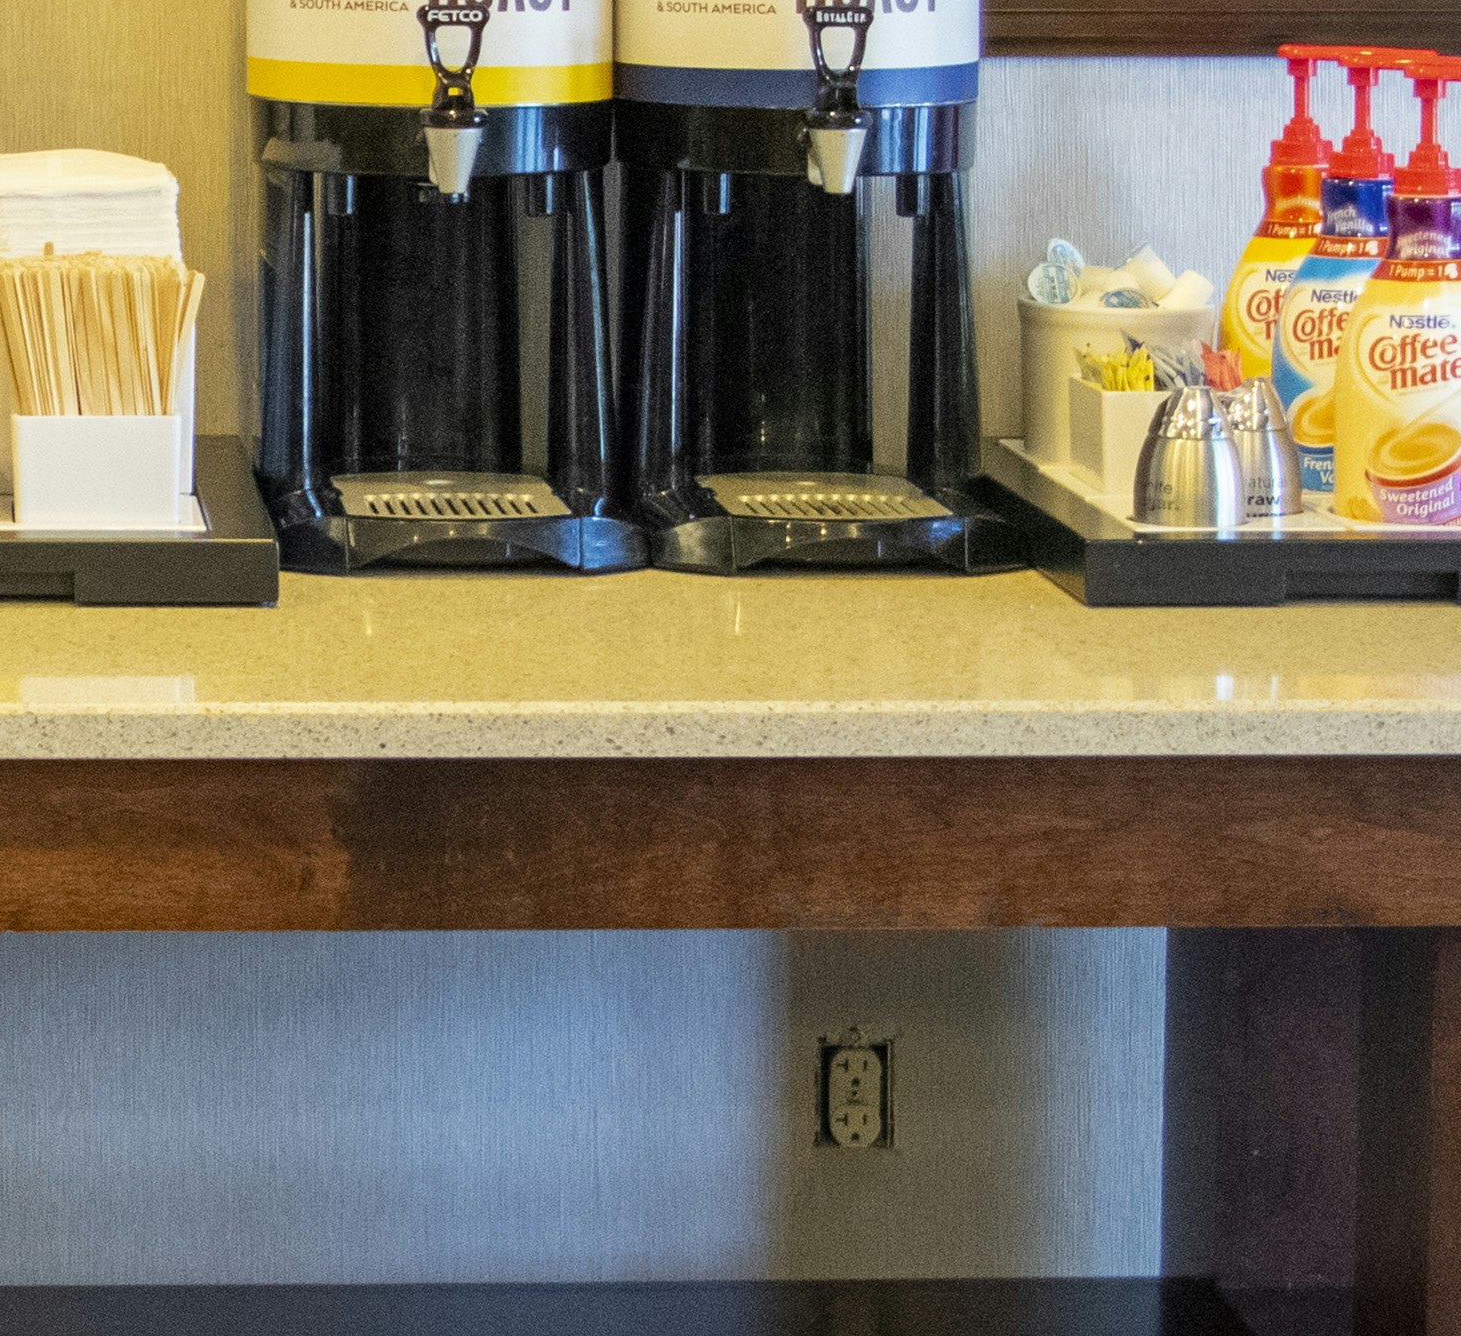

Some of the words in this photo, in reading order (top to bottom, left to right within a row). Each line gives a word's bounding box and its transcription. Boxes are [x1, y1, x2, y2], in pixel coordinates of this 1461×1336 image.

[289, 0, 297, 10] &
[299, 0, 341, 11] SOUTH
[344, 1, 409, 12] AMERICA
[656, 1, 664, 13] &
[666, 2, 708, 14] SOUTH
[711, 3, 777, 15] AMERICA
[427, 9, 483, 22] FETCO
[1395, 265, 1425, 280] Pump
[1292, 309, 1351, 344] Coffe
[1303, 456, 1334, 471] Fren
[1379, 482, 1454, 503] Sweetened
[1396, 493, 1456, 518] Original
